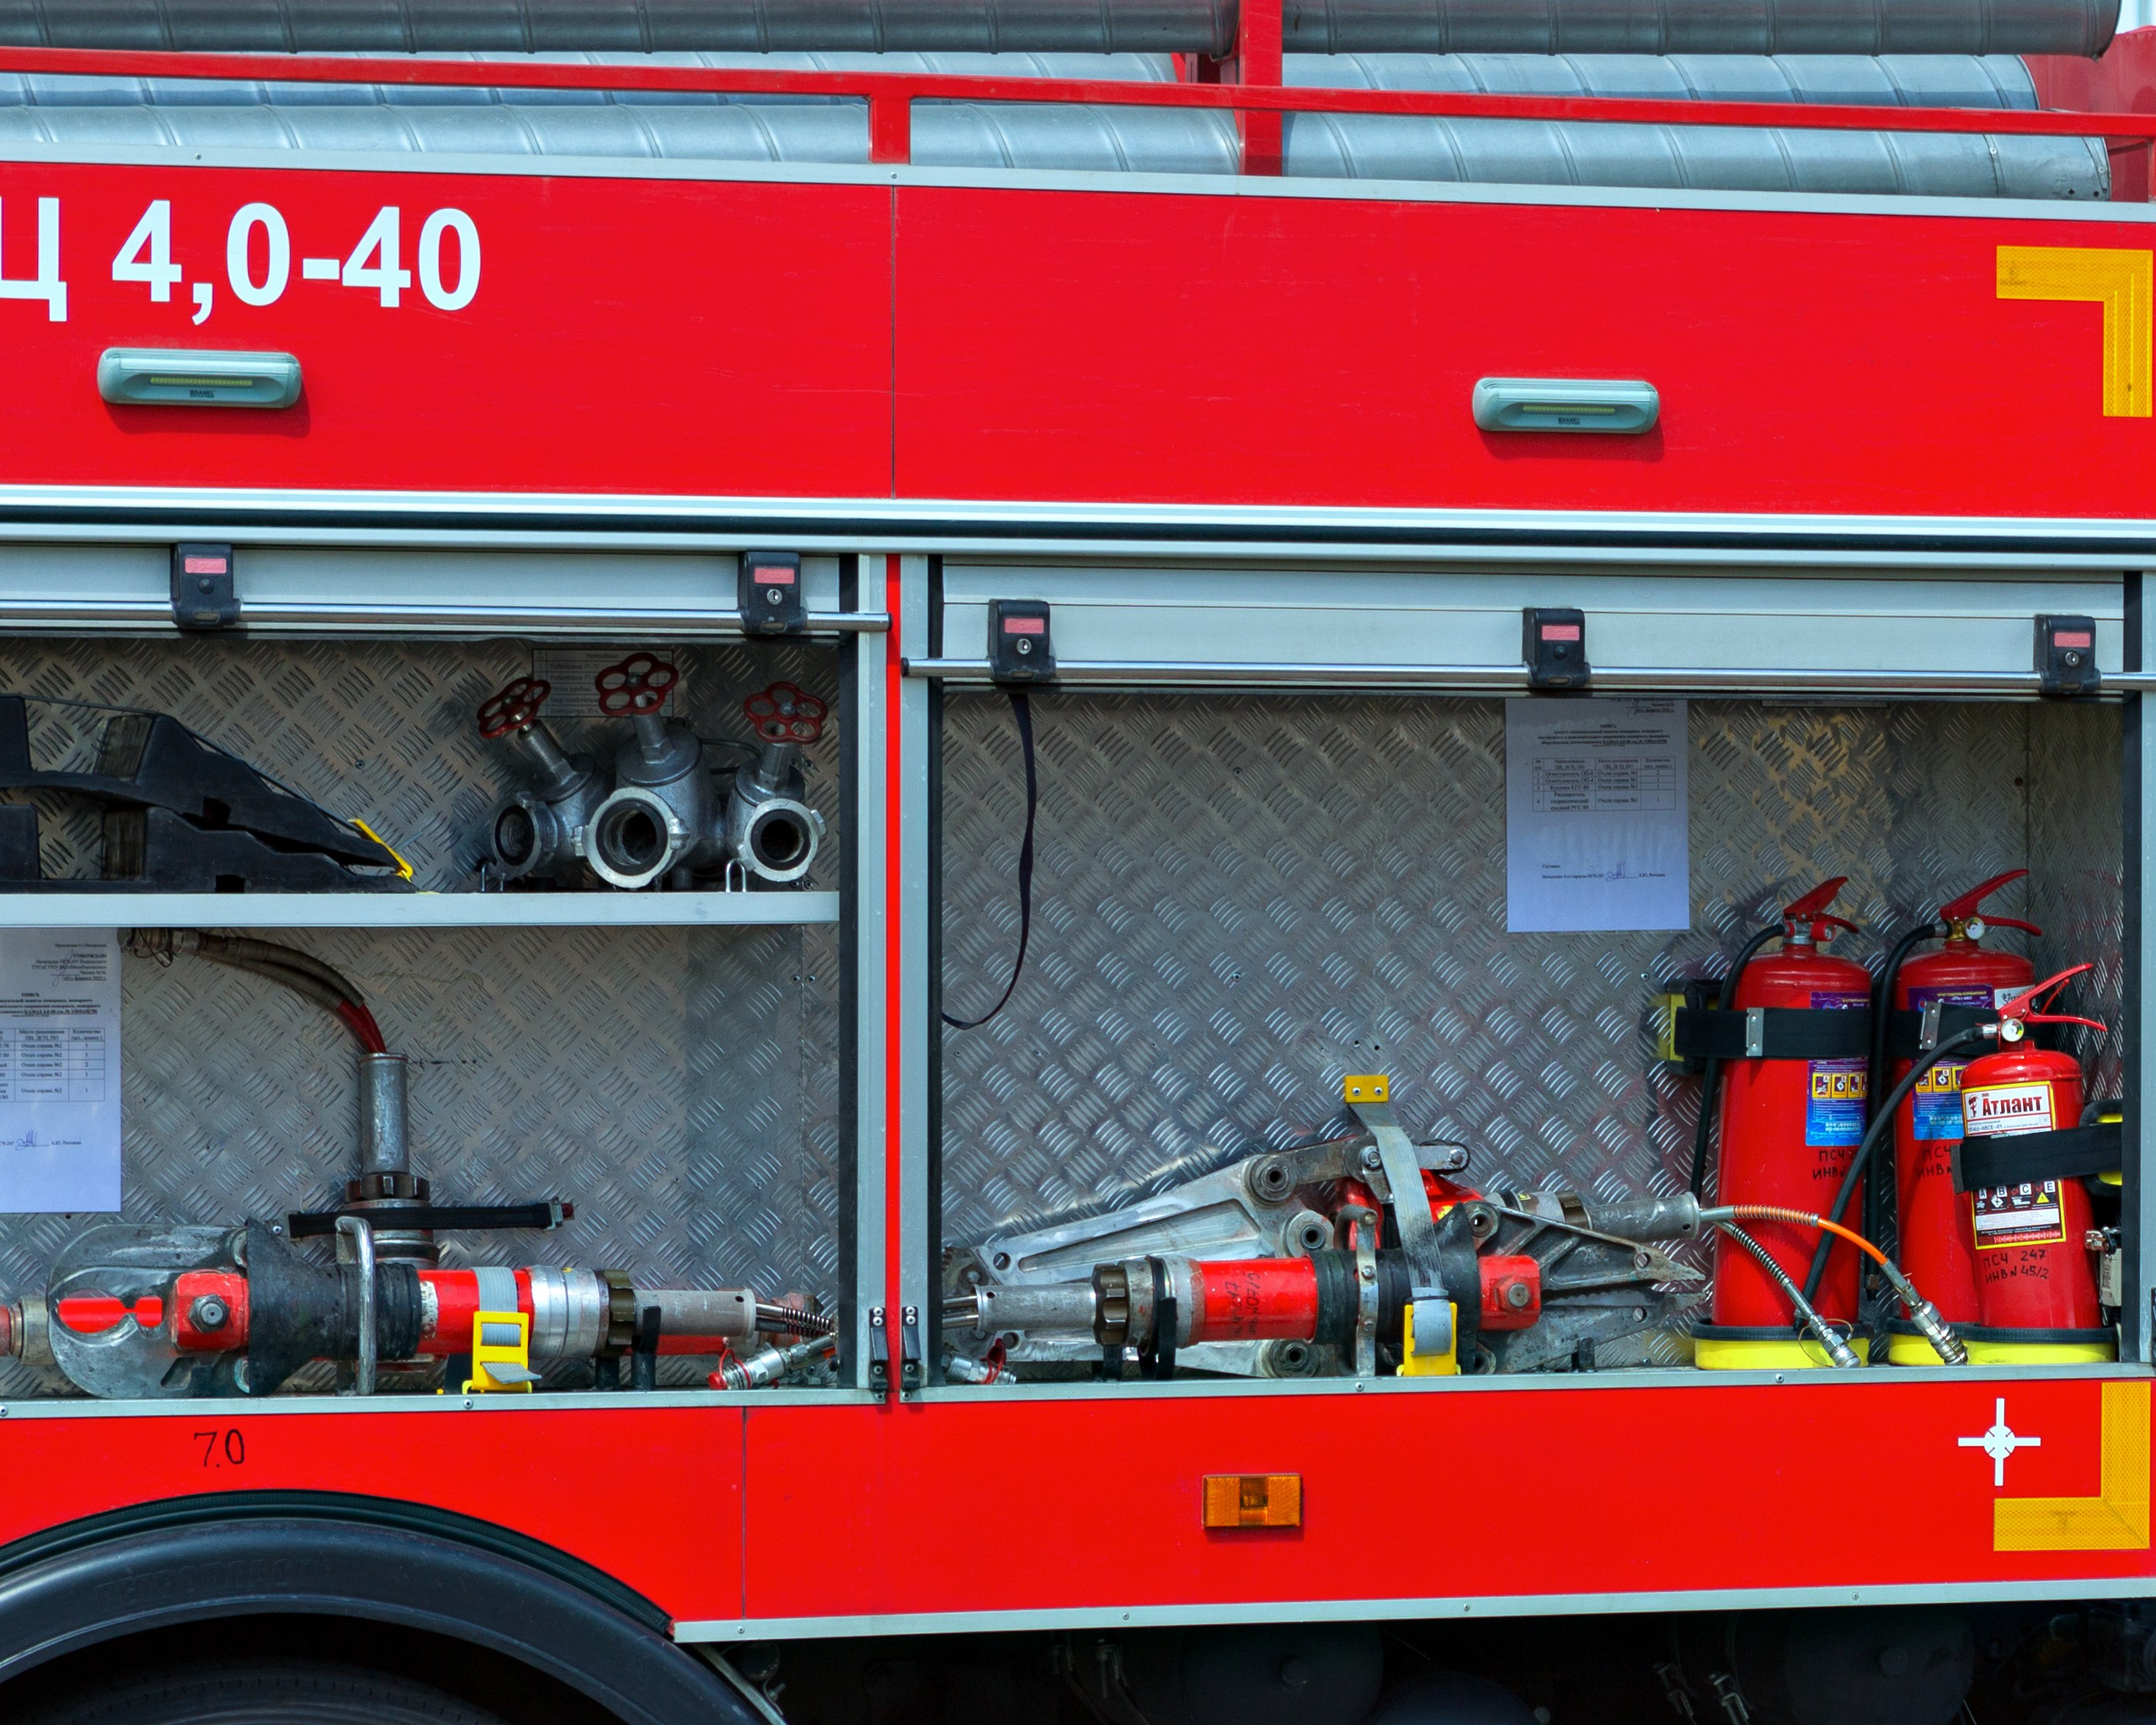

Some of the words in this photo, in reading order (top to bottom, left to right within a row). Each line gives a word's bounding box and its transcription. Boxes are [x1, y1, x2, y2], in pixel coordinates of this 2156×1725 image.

[112, 200, 481, 325] 4,0-40
[1983, 1096, 2042, 1116] Атлант
[1819, 1149, 1844, 1162] ПСЧ
[2022, 1184, 2030, 1194] C
[2047, 1183, 2052, 1191] E
[1983, 1252, 2009, 1269] ПСЧ
[2020, 1248, 2046, 1261] 247
[1985, 1268, 2008, 1284] ИНВ
[2020, 1264, 2048, 1279] 45/2
[194, 1429, 244, 1467] 7.0
